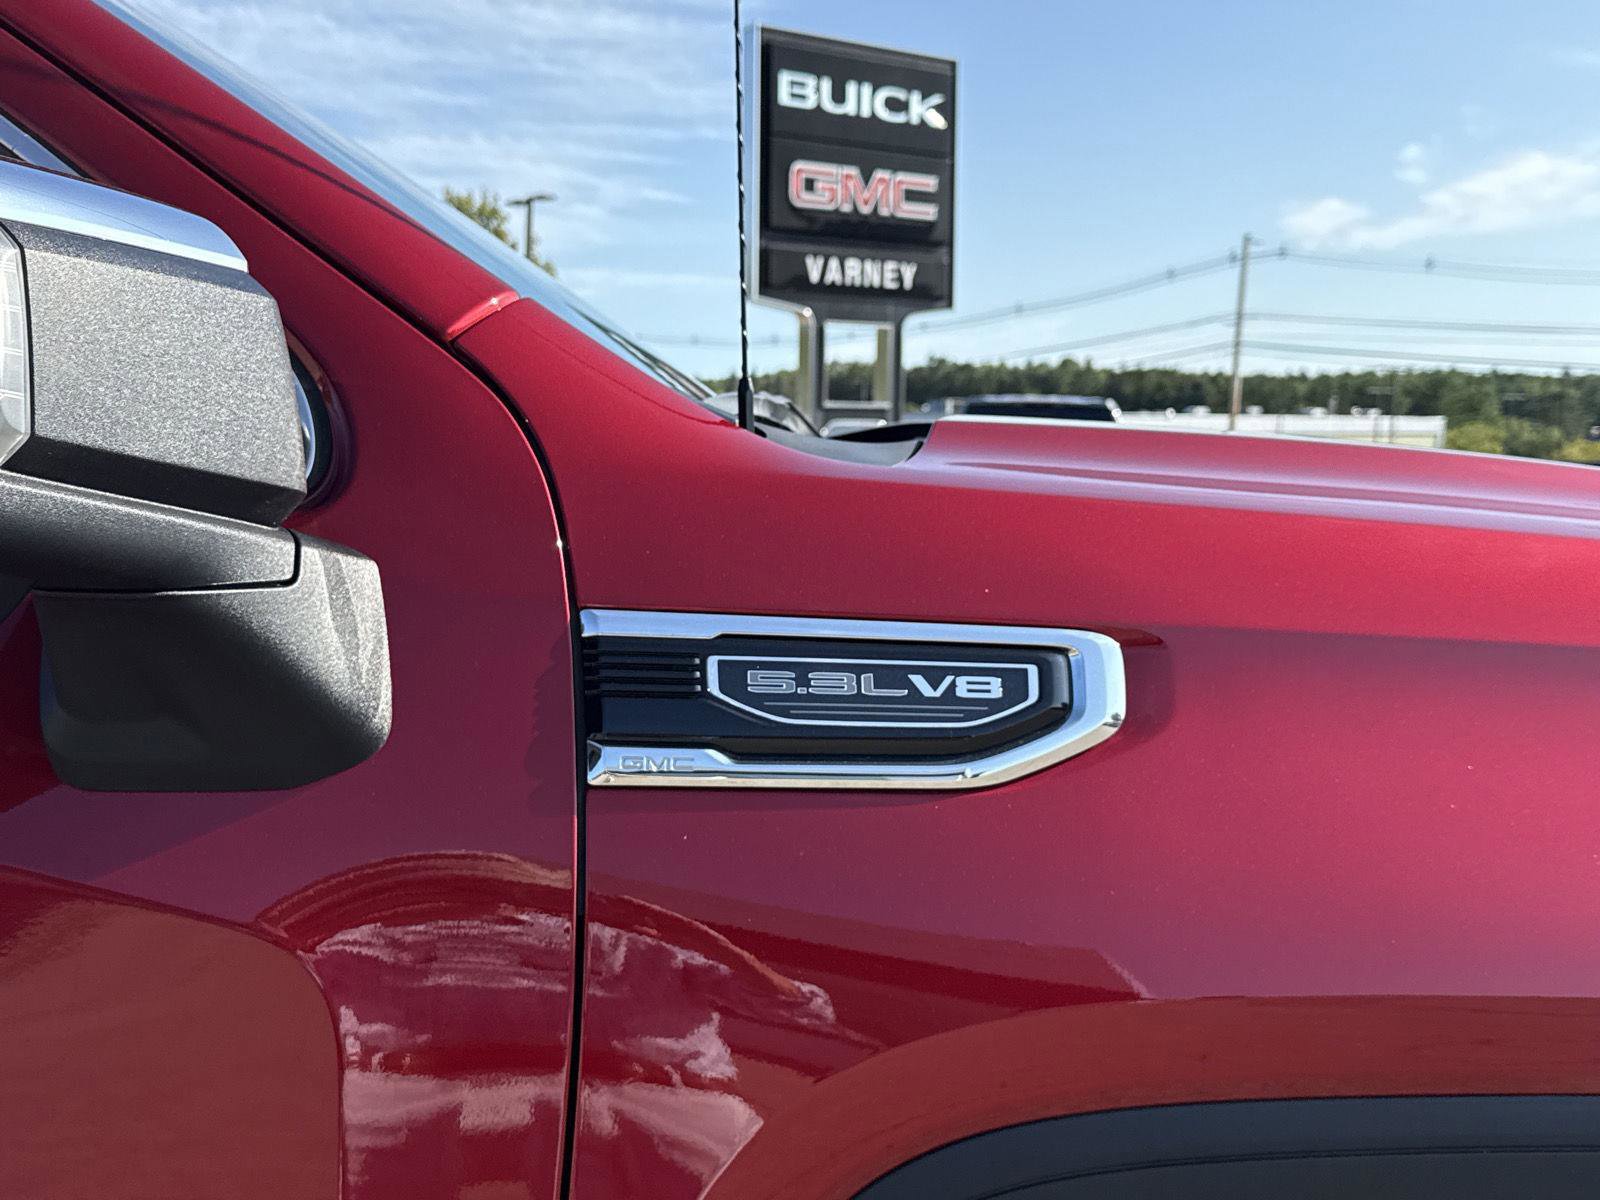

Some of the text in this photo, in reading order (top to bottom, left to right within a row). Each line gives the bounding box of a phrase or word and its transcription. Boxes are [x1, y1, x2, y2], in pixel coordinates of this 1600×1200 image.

[777, 68, 948, 130] BUICK
[788, 159, 939, 221] GMC
[804, 253, 918, 291] VARNEY
[620, 756, 695, 771] GMC
